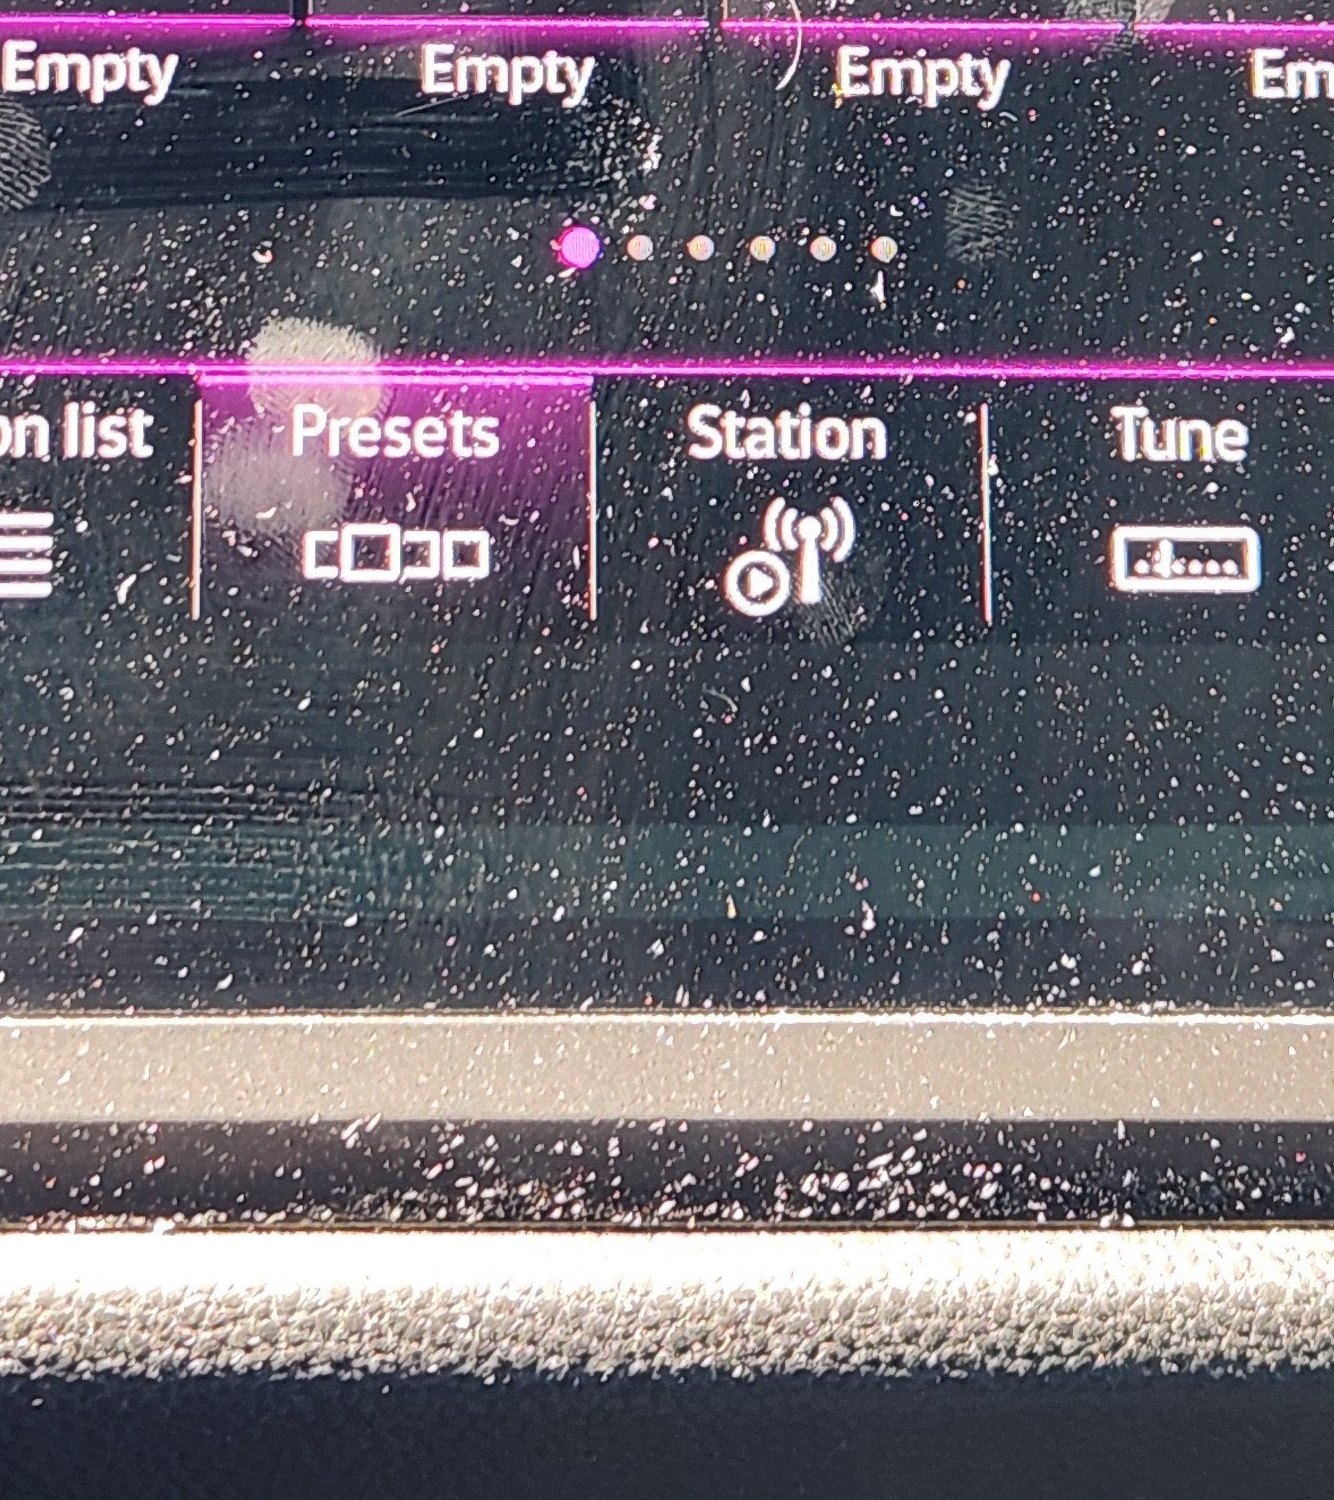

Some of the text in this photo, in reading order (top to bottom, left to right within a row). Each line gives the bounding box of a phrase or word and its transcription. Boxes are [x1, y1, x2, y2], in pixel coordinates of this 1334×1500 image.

[0, 38, 179, 106] Empty
[419, 42, 597, 108] Empty
[834, 44, 1012, 111] Empty
[65, 401, 154, 459] list
[291, 403, 501, 459] Presets
[686, 403, 889, 462] Station
[1110, 405, 1250, 464] Tune
